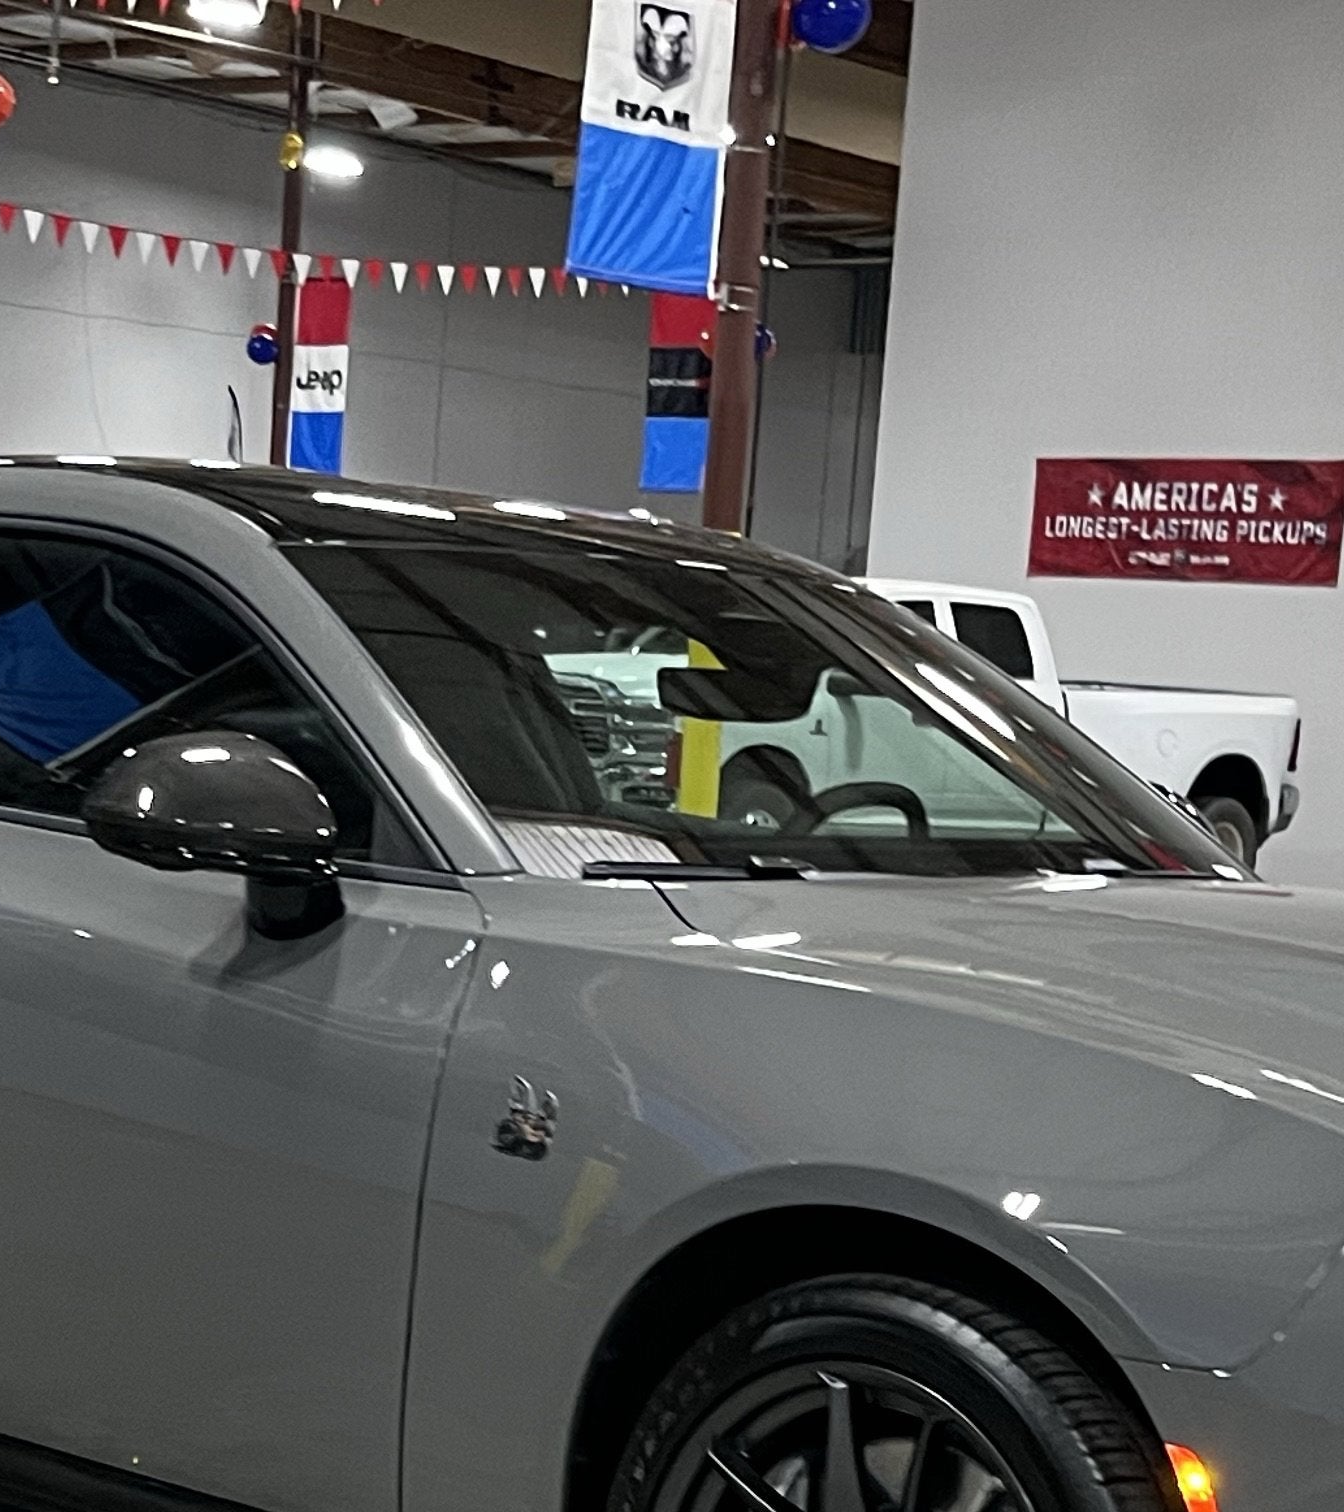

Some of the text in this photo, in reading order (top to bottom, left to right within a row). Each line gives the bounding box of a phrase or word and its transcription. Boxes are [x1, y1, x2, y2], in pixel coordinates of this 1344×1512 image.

[616, 98, 691, 132] RAM
[1111, 480, 1259, 513] AMERICA'S
[1044, 515, 1328, 545] LONGEST-LASTING PICKUPS
